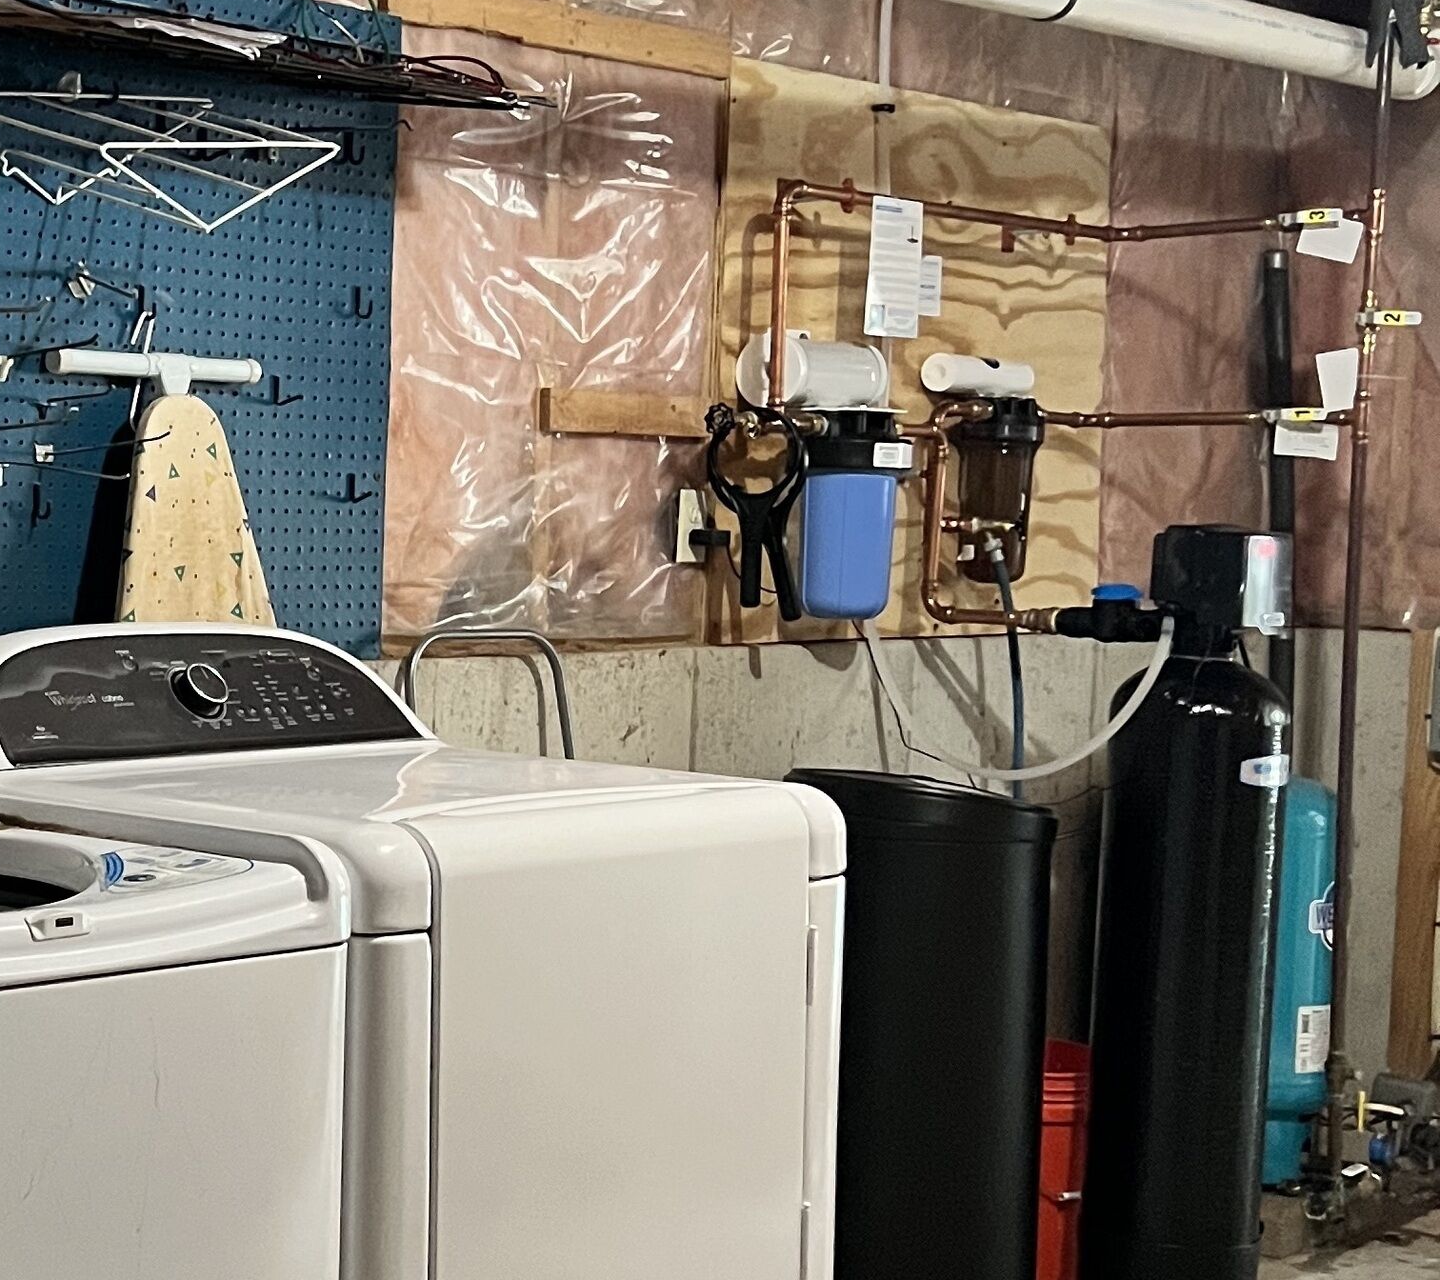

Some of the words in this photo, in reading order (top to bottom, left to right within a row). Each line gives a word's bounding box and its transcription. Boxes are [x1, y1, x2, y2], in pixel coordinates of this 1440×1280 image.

[1309, 210, 1325, 221] 3
[1383, 312, 1401, 323] 2
[1295, 409, 1311, 418] 1
